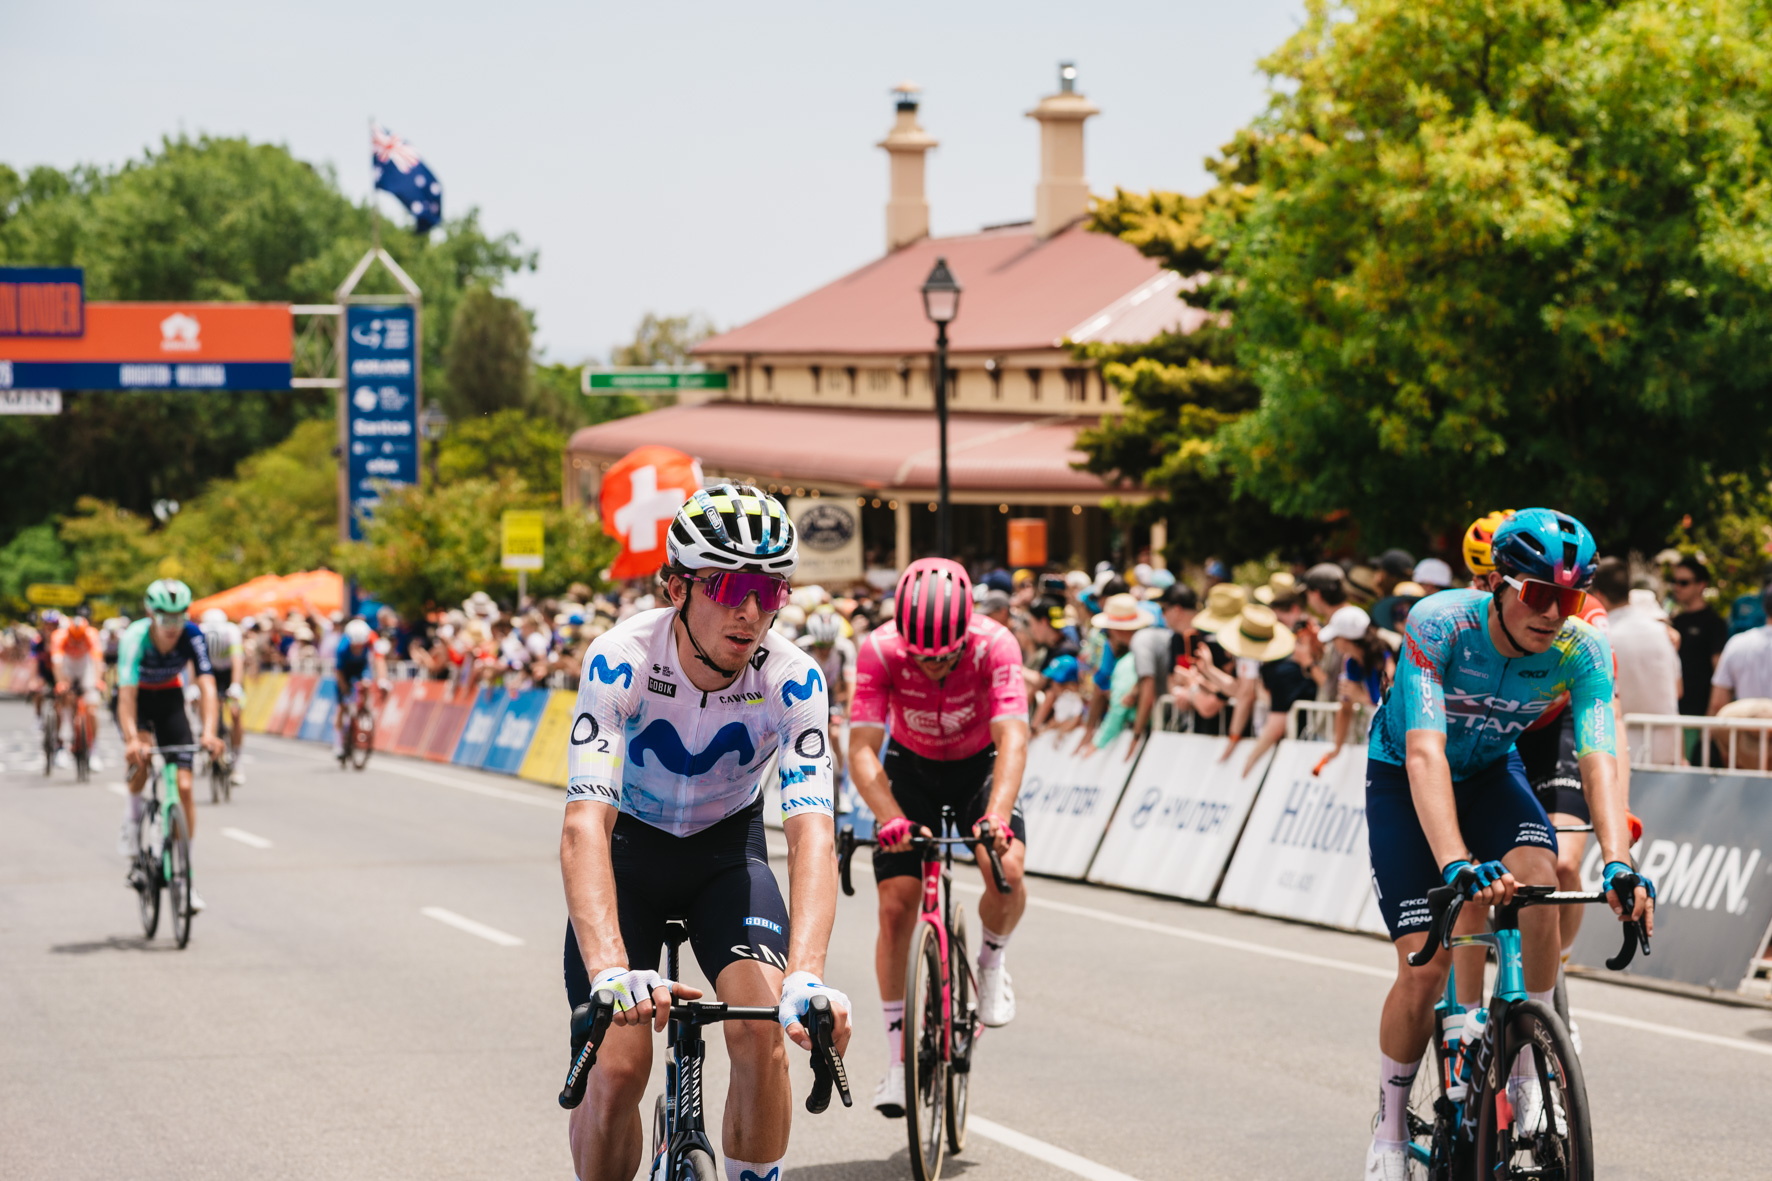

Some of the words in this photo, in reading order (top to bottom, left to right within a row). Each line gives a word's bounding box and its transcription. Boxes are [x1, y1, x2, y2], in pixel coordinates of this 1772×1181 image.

[649, 678, 674, 695] GOBIK
[719, 690, 763, 704] CANYON
[1594, 698, 1604, 745] ASTANA
[1270, 779, 1366, 855] Hilton
[1579, 839, 1761, 914] GRMIN
[745, 917, 780, 933] GOBIK
[567, 1041, 594, 1087] SRAM
[680, 1055, 690, 1118] CANYON
[692, 1056, 701, 1118] CANYON
[828, 1046, 849, 1091] SRAM
